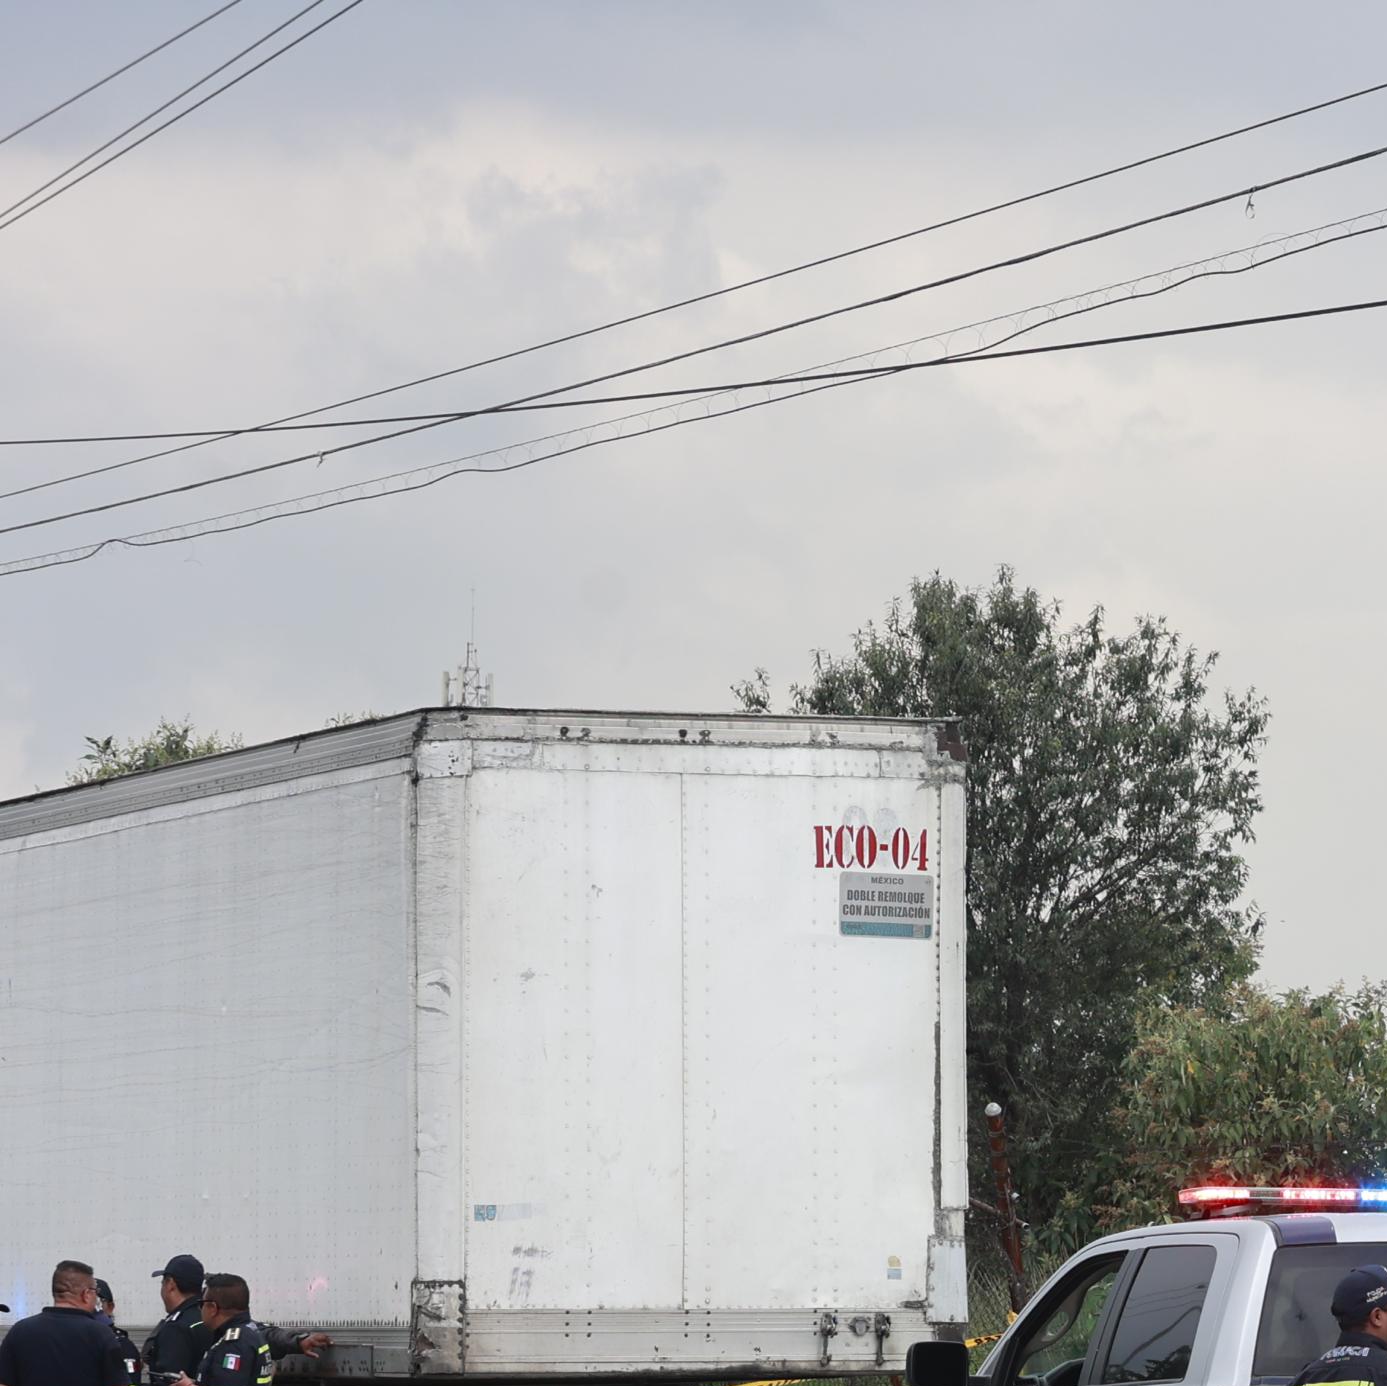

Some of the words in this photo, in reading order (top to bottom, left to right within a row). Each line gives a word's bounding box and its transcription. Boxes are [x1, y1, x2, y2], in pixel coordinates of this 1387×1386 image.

[813, 824, 929, 872] ECO-04
[847, 889, 876, 902] DOBLE
[877, 890, 925, 904] REMOLQUE
[842, 904, 862, 916] CON
[863, 904, 931, 919] AUTORIZACIÓN
